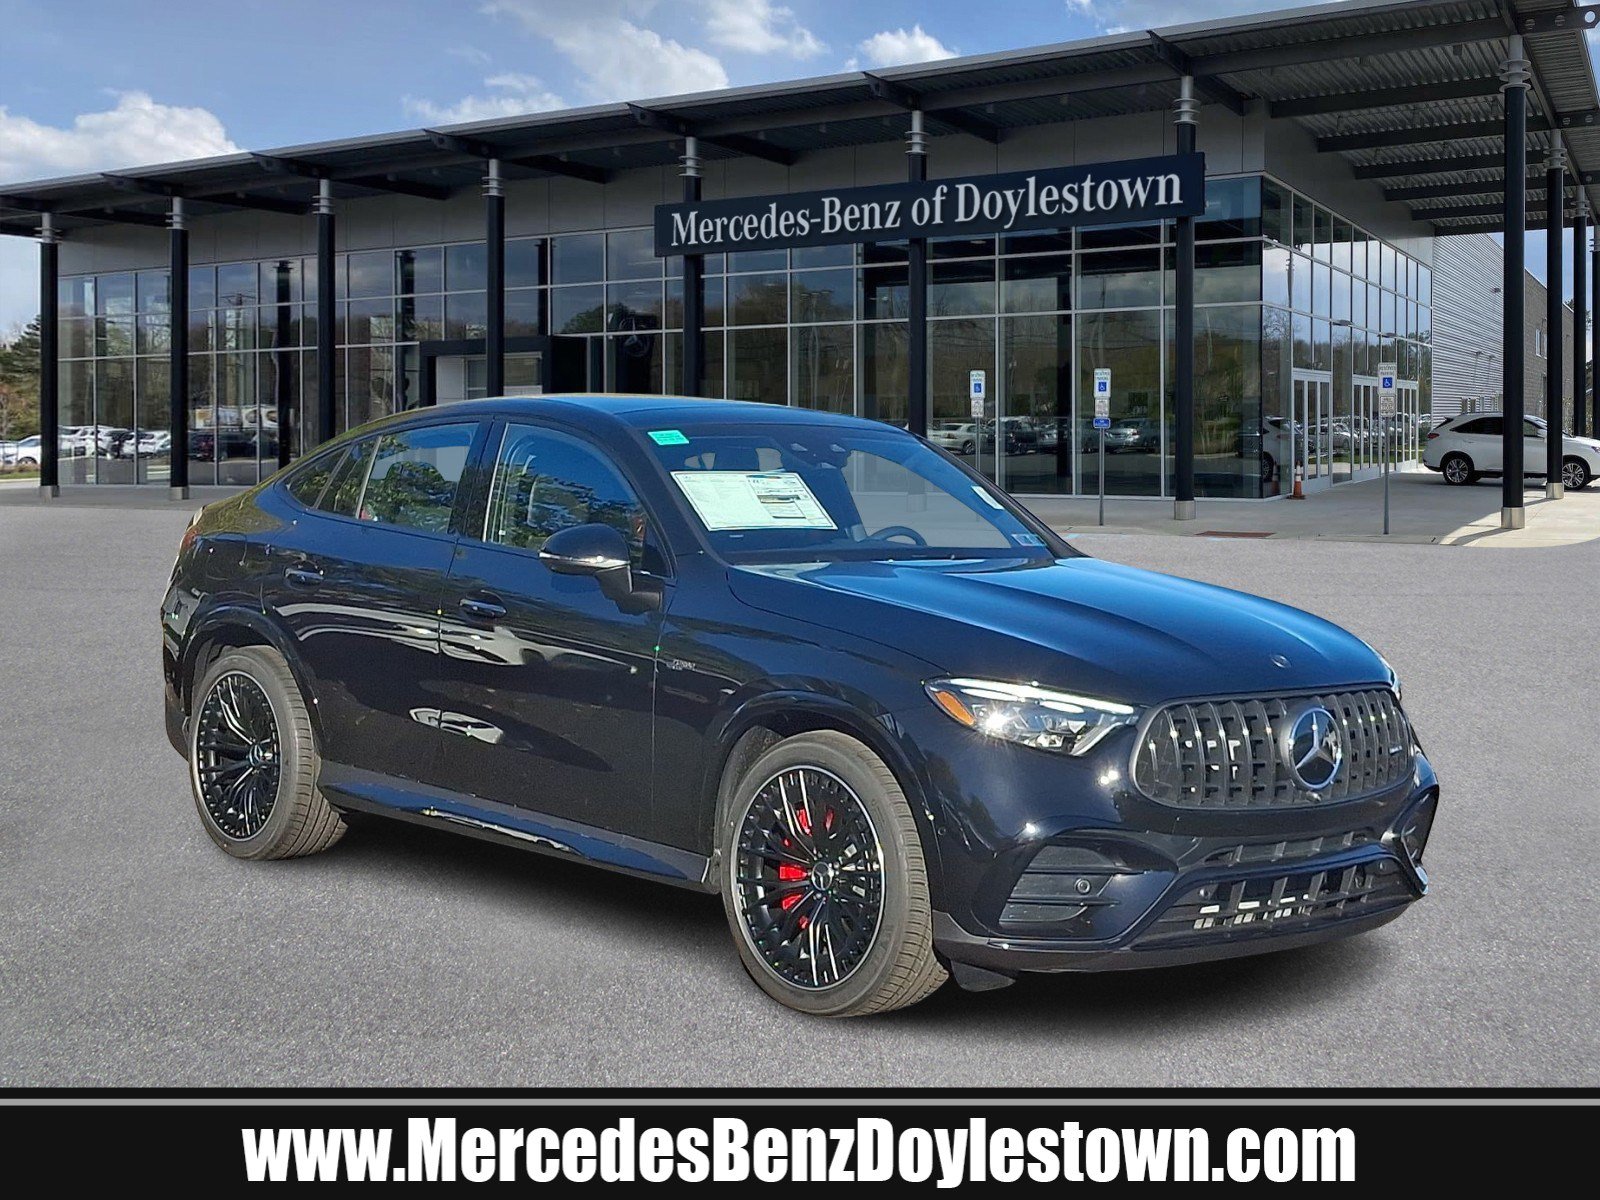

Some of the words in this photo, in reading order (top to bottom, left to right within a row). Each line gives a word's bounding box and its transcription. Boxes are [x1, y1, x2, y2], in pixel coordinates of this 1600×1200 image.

[671, 197, 901, 246] Mercedes-Benz
[911, 184, 949, 227] of
[954, 172, 1184, 229] Doylestown
